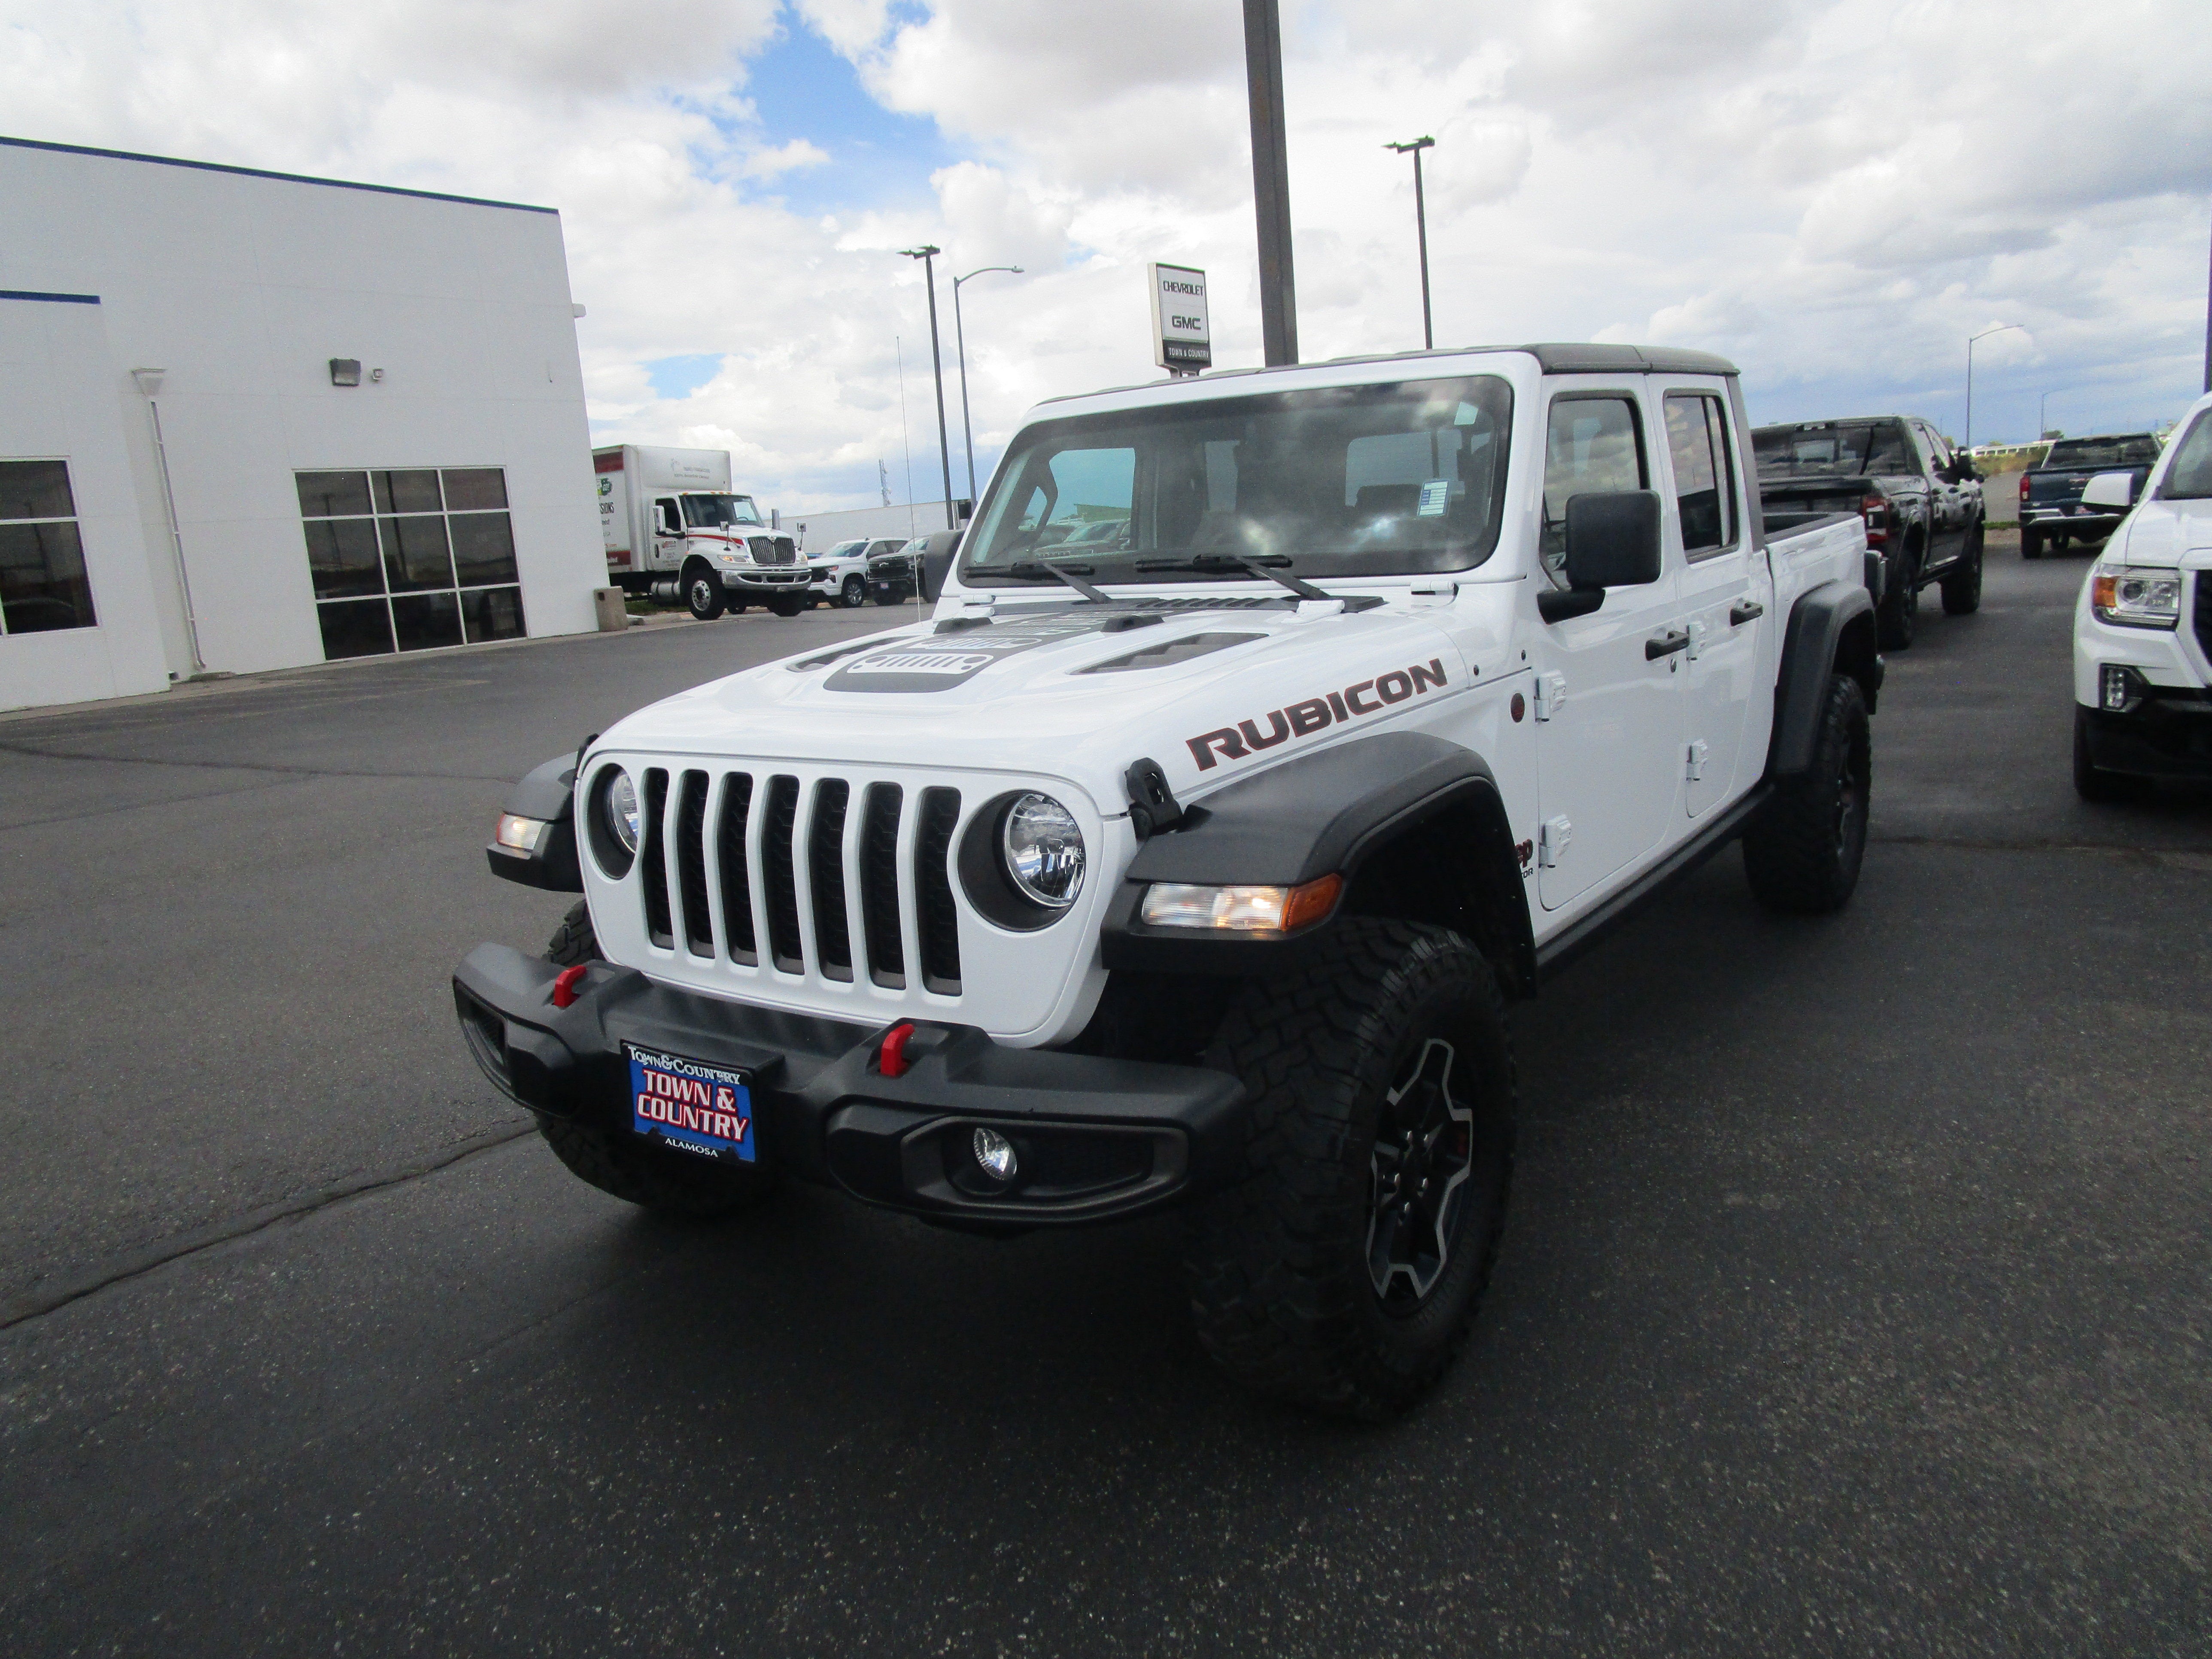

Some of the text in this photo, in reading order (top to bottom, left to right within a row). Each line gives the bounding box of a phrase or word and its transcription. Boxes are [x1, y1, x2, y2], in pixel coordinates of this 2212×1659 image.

[1163, 280, 1203, 296] CHEVROLET
[1172, 315, 1201, 330] GMC
[1169, 347, 1182, 356] TOWN
[1188, 349, 1209, 358] COUNTRY
[1185, 658, 1448, 772] RUBICON
[643, 1069, 737, 1112] TOWN &
[638, 1094, 747, 1142] COUNTRY
[665, 1138, 718, 1157] ALAMOSA
